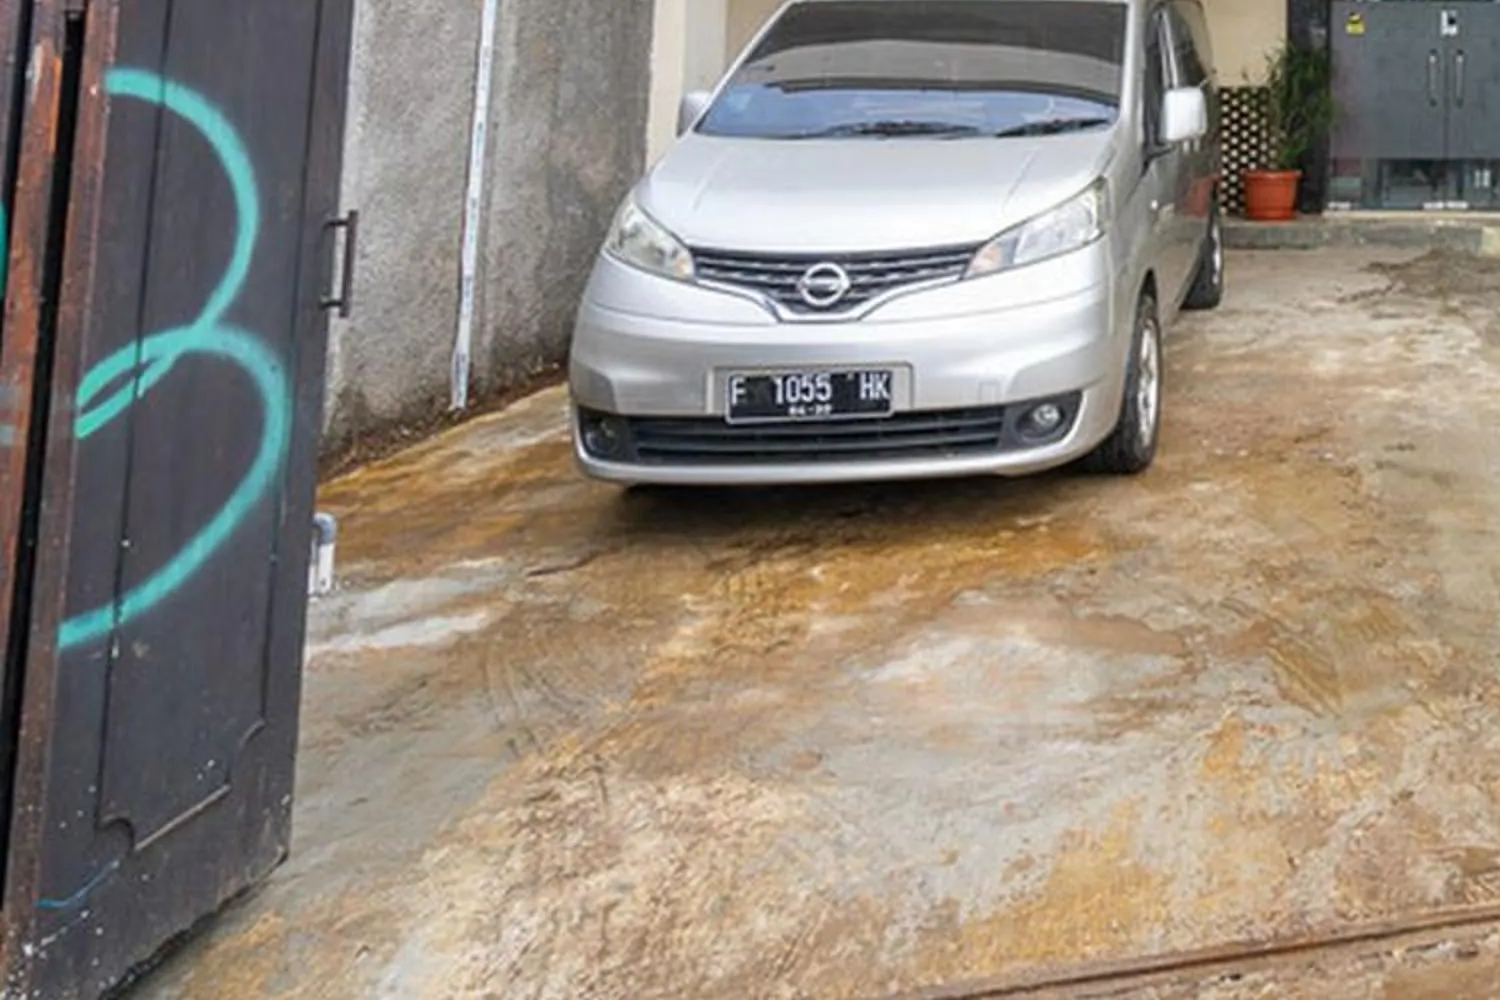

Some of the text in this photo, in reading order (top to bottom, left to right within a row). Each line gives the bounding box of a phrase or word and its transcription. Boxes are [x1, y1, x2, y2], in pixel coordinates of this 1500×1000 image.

[730, 371, 891, 405] F 1055 HK
